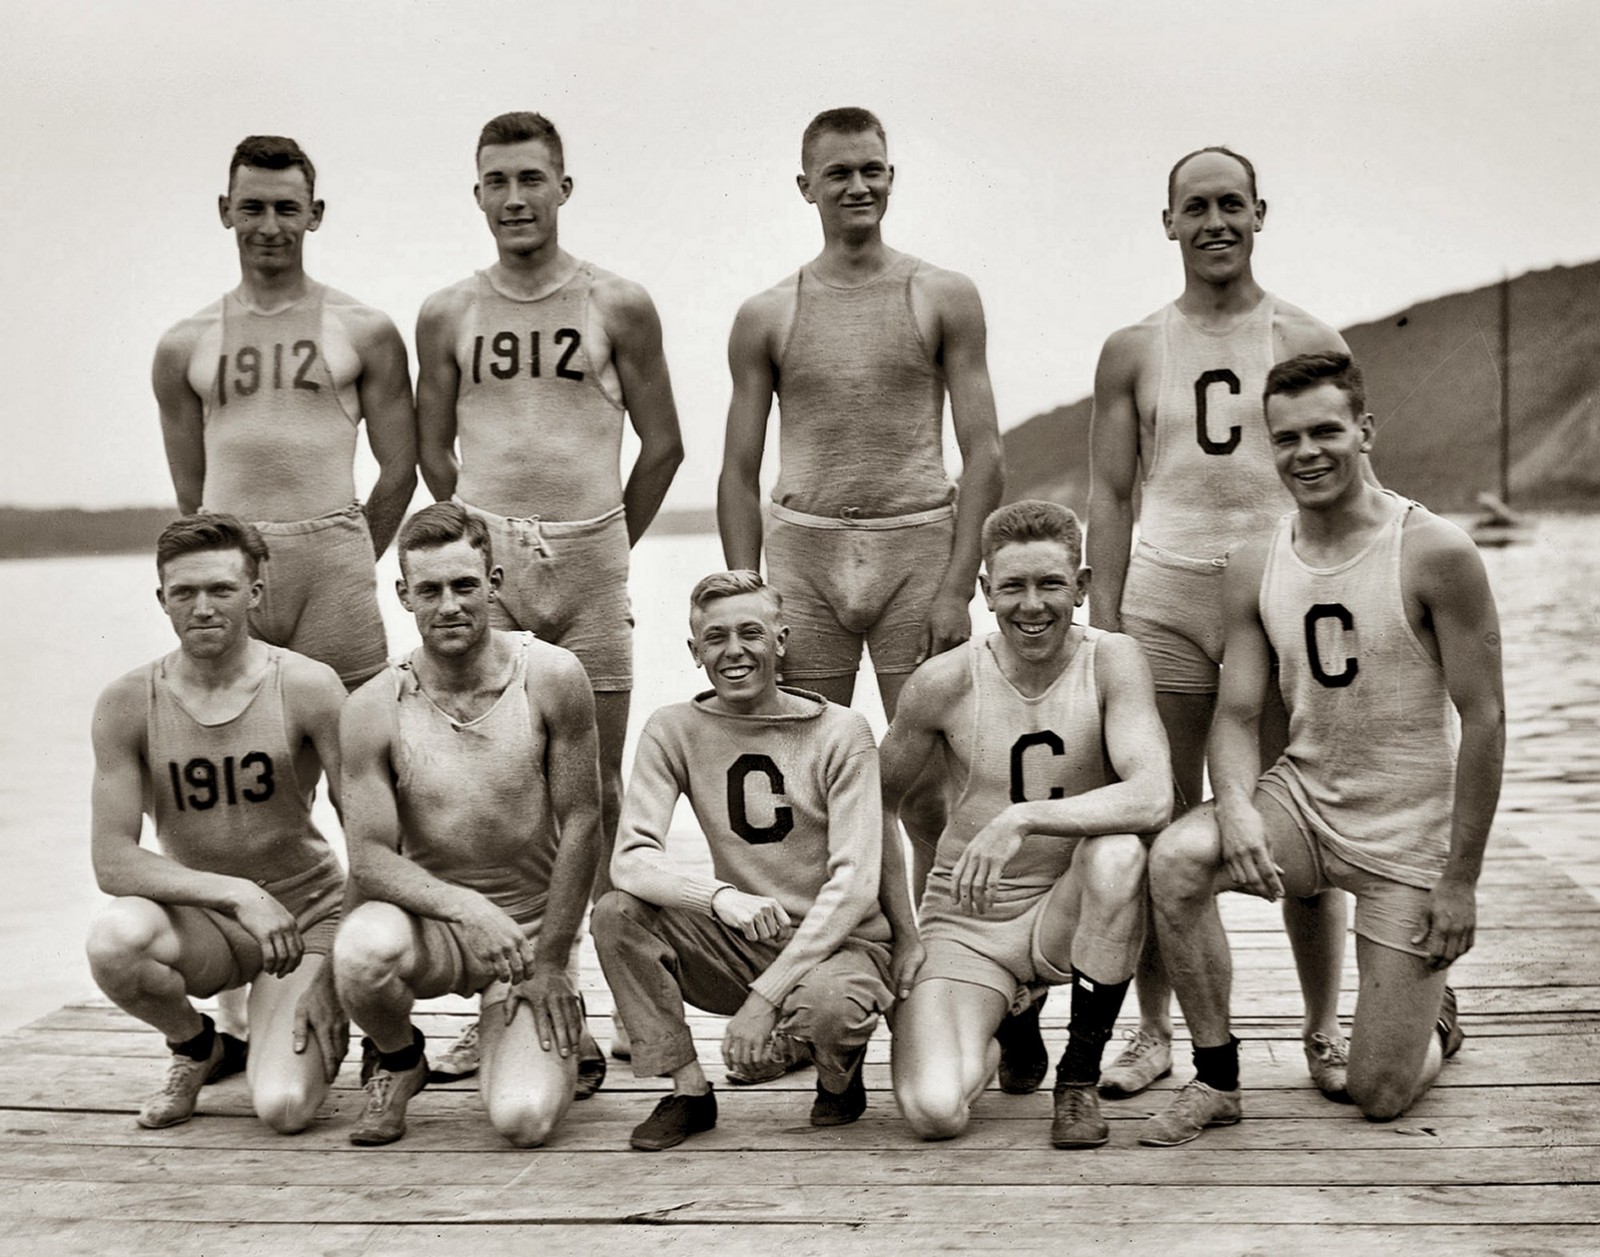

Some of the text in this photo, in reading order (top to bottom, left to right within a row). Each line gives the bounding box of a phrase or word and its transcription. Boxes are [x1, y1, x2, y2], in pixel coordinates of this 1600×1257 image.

[219, 340, 320, 405] 1912
[471, 327, 585, 384] 1912
[1195, 369, 1242, 455] C
[1305, 603, 1358, 688] C
[169, 752, 275, 811] 1913
[727, 754, 794, 845] C
[1010, 730, 1065, 804] C
